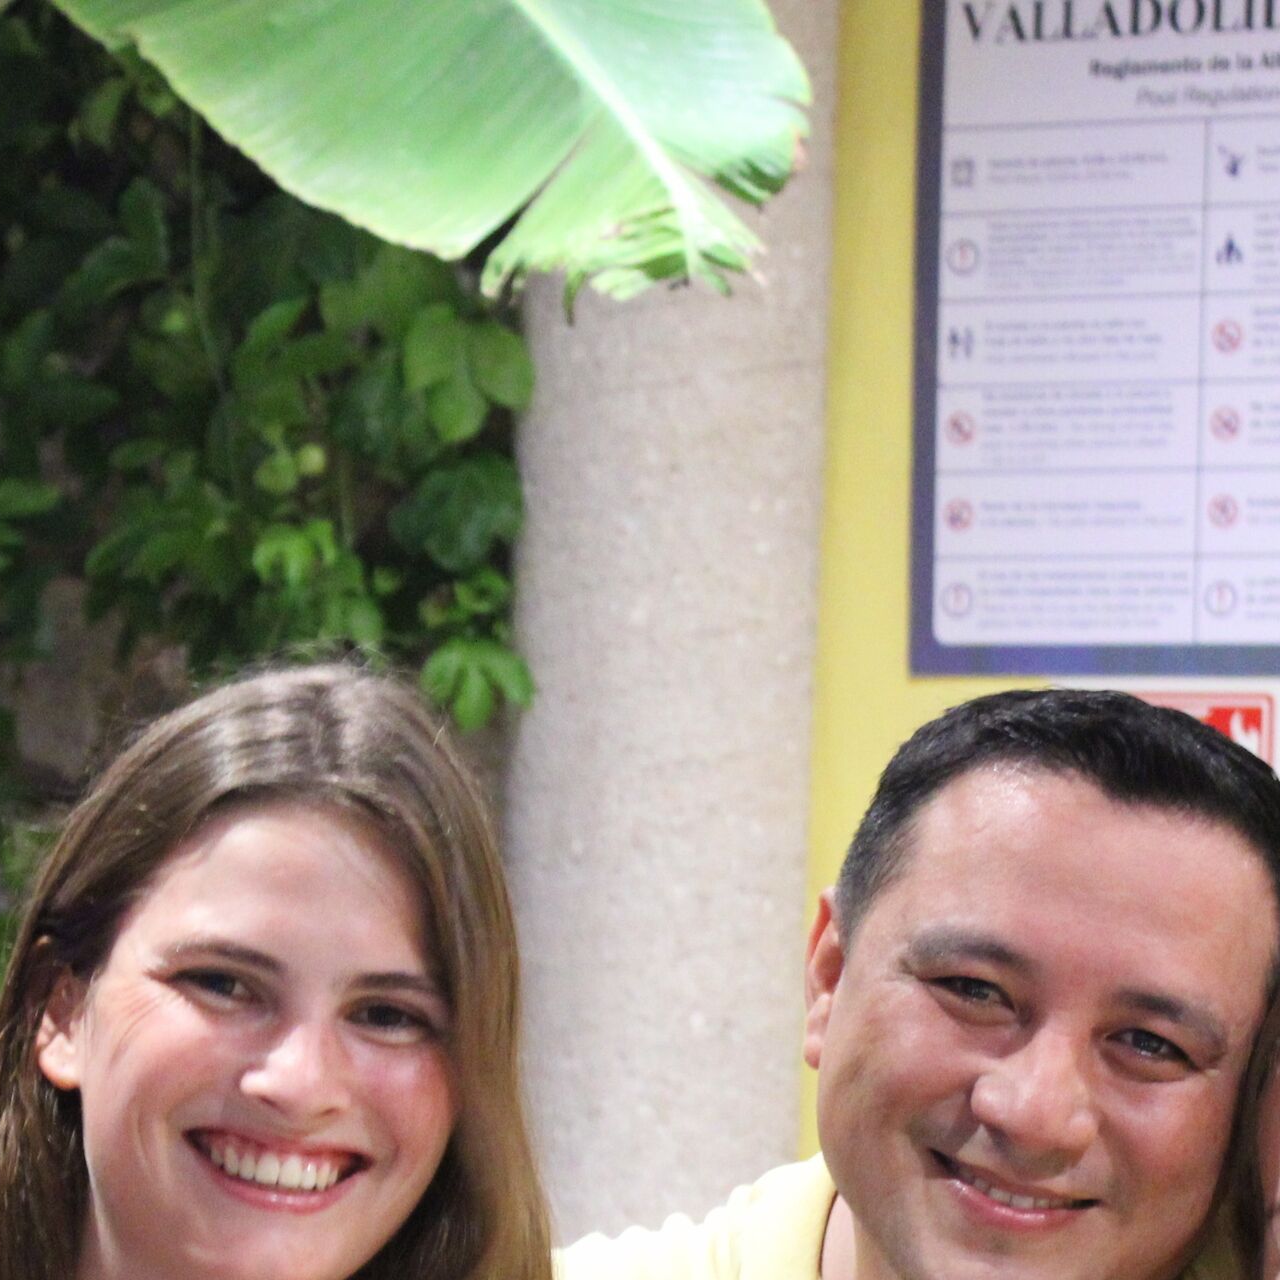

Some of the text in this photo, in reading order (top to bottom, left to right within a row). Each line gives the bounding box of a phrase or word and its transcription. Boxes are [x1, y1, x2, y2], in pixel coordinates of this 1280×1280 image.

[1089, 56, 1203, 81] Reglamento
[1207, 54, 1231, 73] de
[1235, 53, 1254, 71] la
